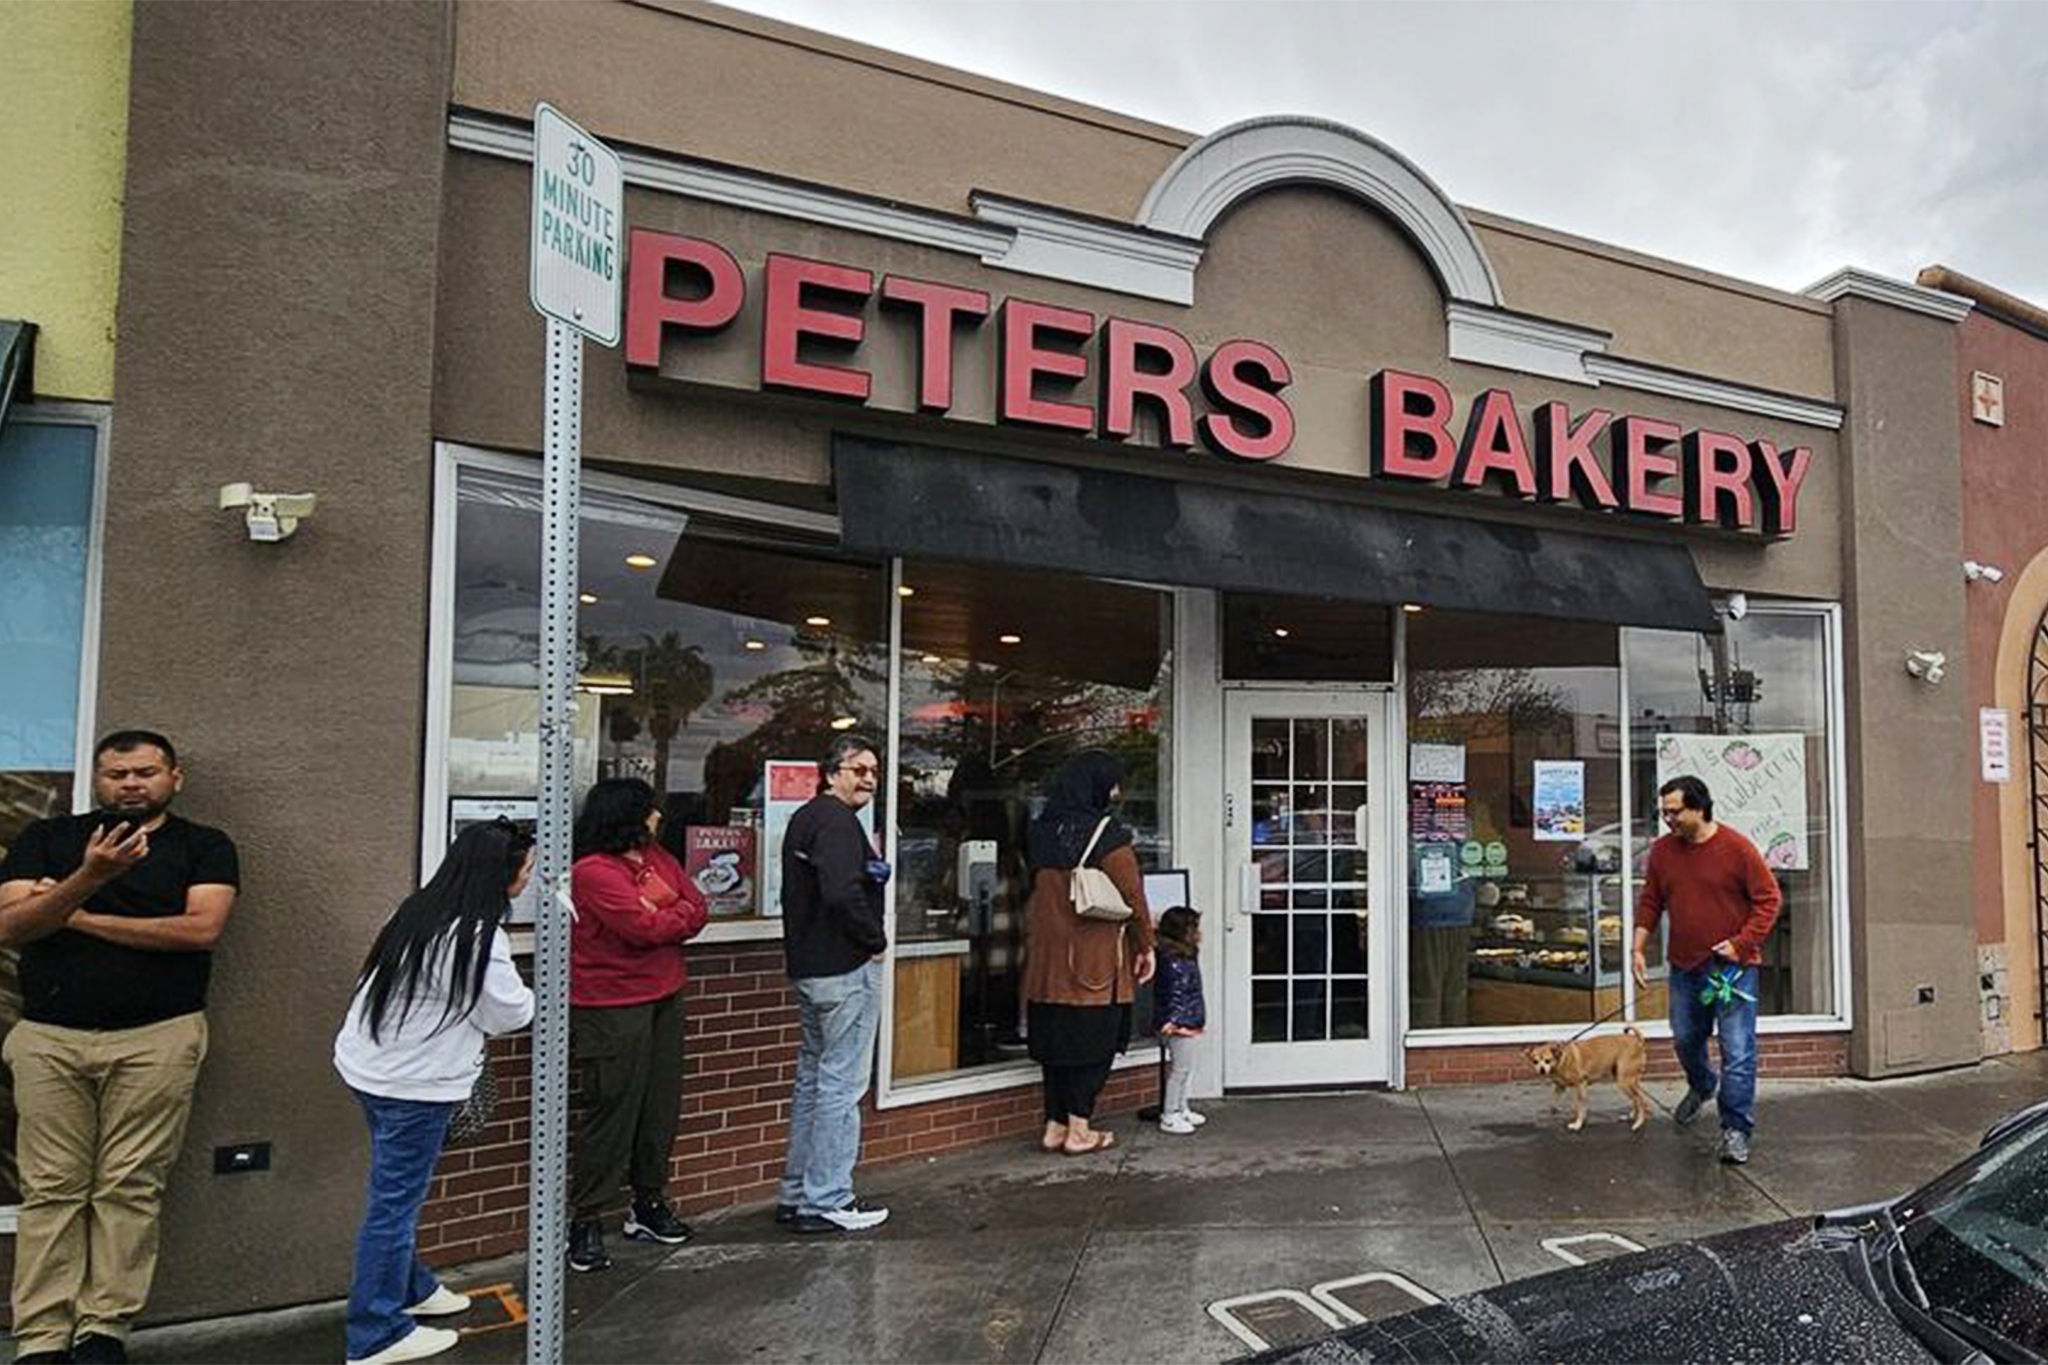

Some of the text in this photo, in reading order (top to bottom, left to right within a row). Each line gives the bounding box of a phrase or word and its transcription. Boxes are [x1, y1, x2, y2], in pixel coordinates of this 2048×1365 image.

[567, 142, 596, 187] 30
[543, 169, 614, 242] MINUTE
[542, 210, 613, 281] PARKING
[625, 226, 1812, 536] PETERS BAKERY
